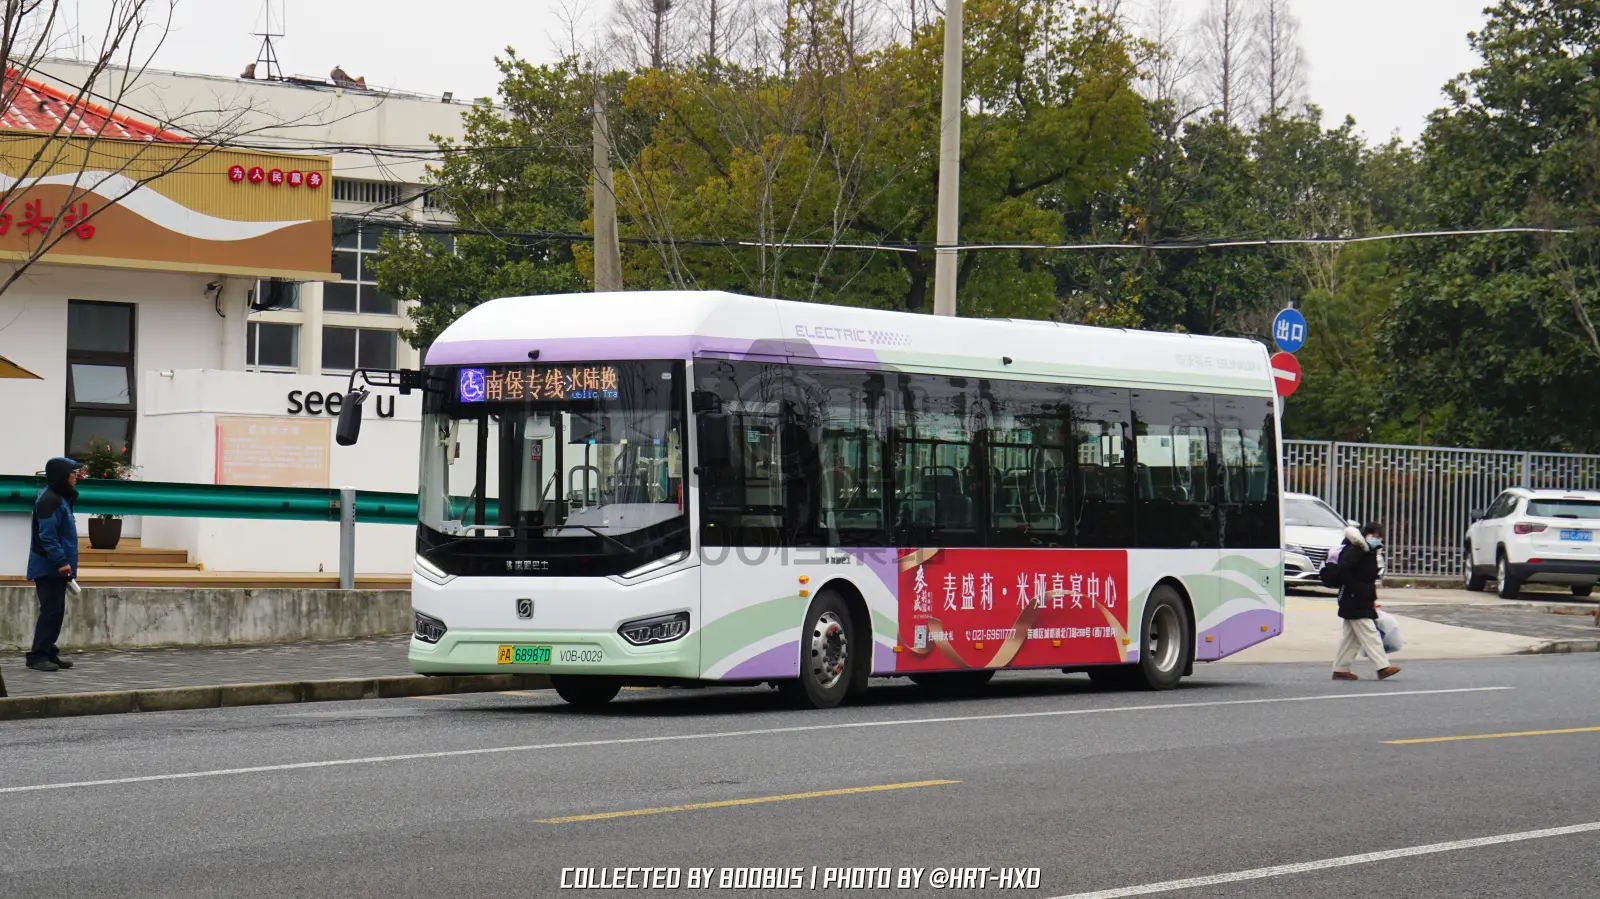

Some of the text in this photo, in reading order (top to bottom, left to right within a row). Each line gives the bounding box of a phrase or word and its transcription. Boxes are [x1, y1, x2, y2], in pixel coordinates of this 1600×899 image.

[231, 165, 323, 189] 为人民服务
[795, 324, 867, 342] ELECTRIC
[1276, 319, 1304, 342] 出口
[486, 369, 563, 400] 南堡专线
[287, 390, 395, 418] see u
[943, 571, 1118, 612] 麦盛莉·米娅喜宴中心
